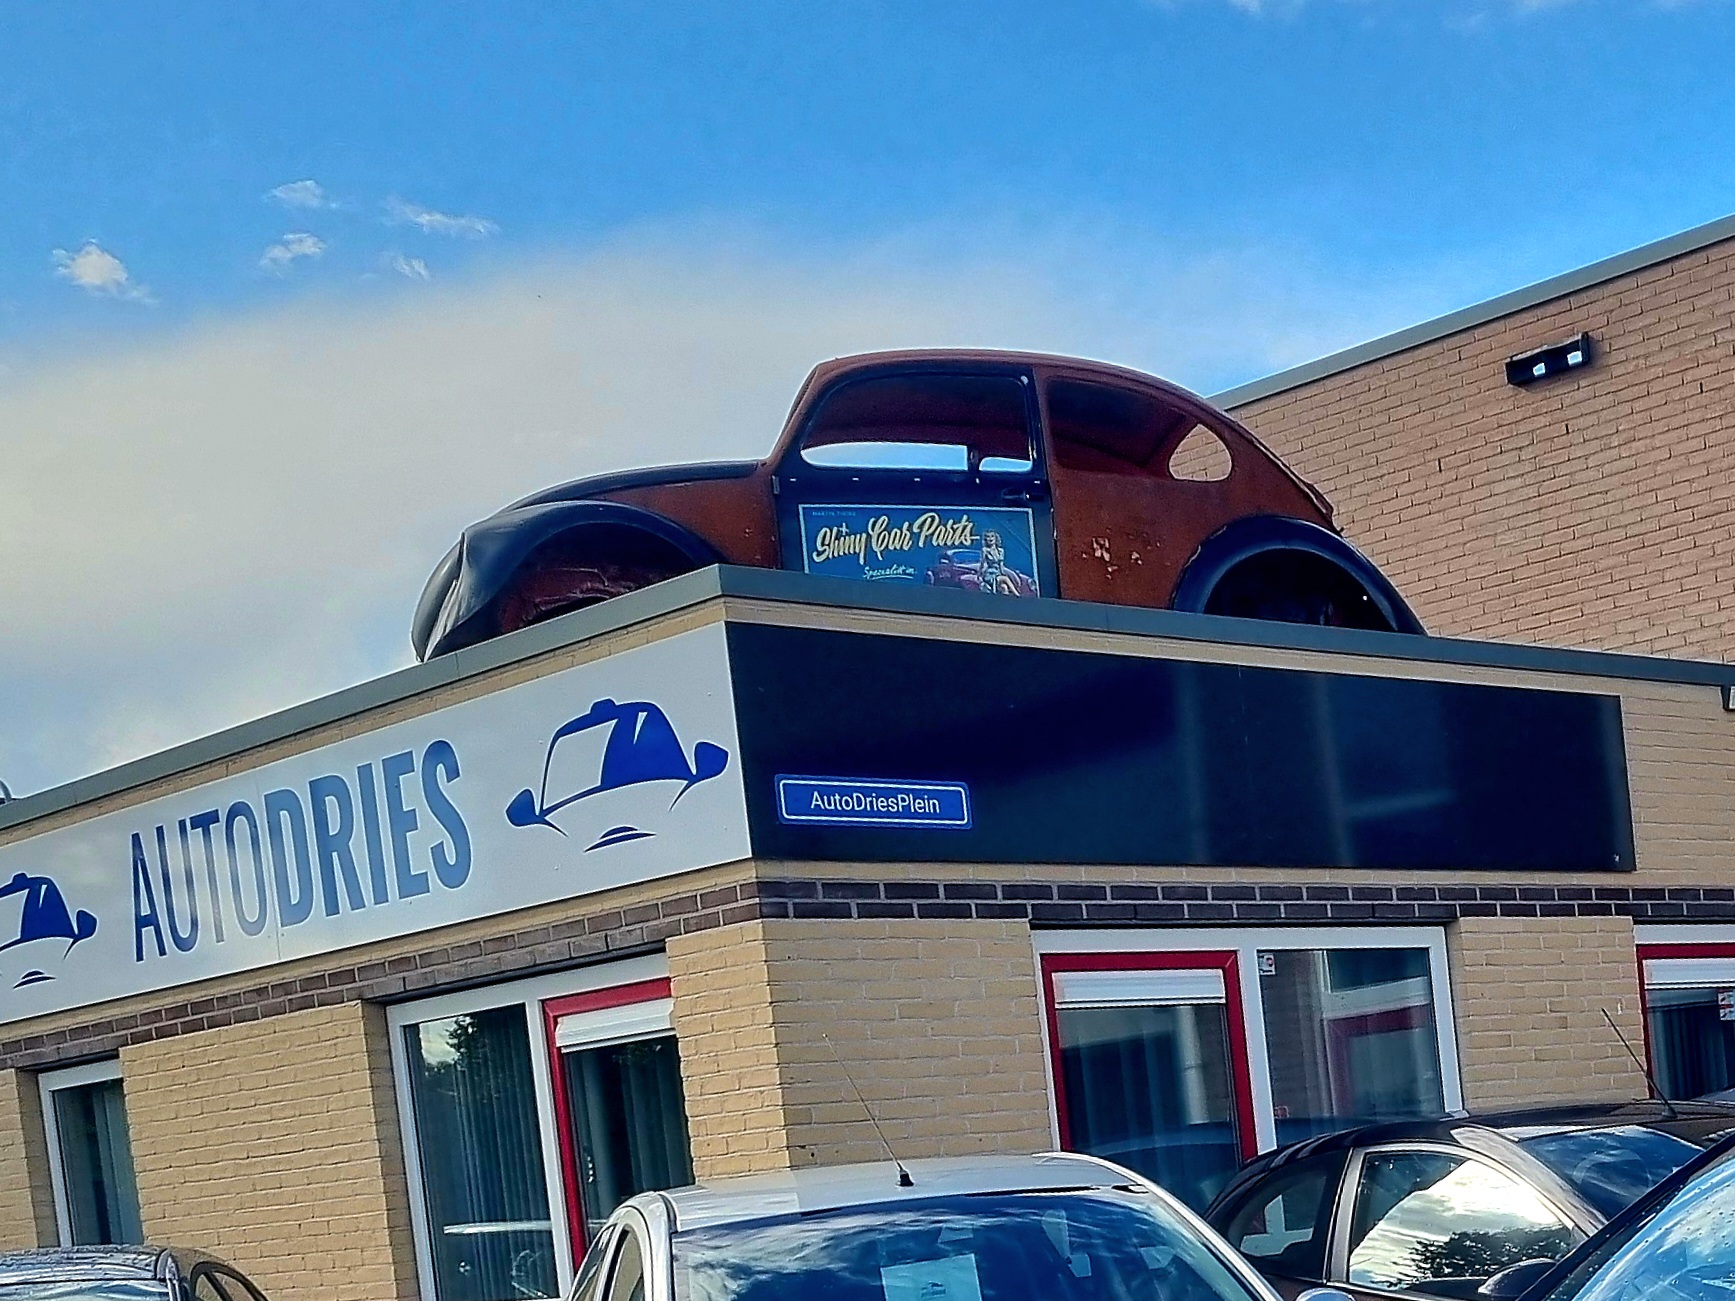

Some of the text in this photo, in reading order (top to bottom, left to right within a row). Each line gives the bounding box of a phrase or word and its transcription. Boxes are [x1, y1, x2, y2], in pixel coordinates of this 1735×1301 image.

[812, 512, 980, 564] Shiny Car Parts
[810, 790, 940, 814] AutoDriesPlein
[131, 738, 472, 963] AUTODRIES
